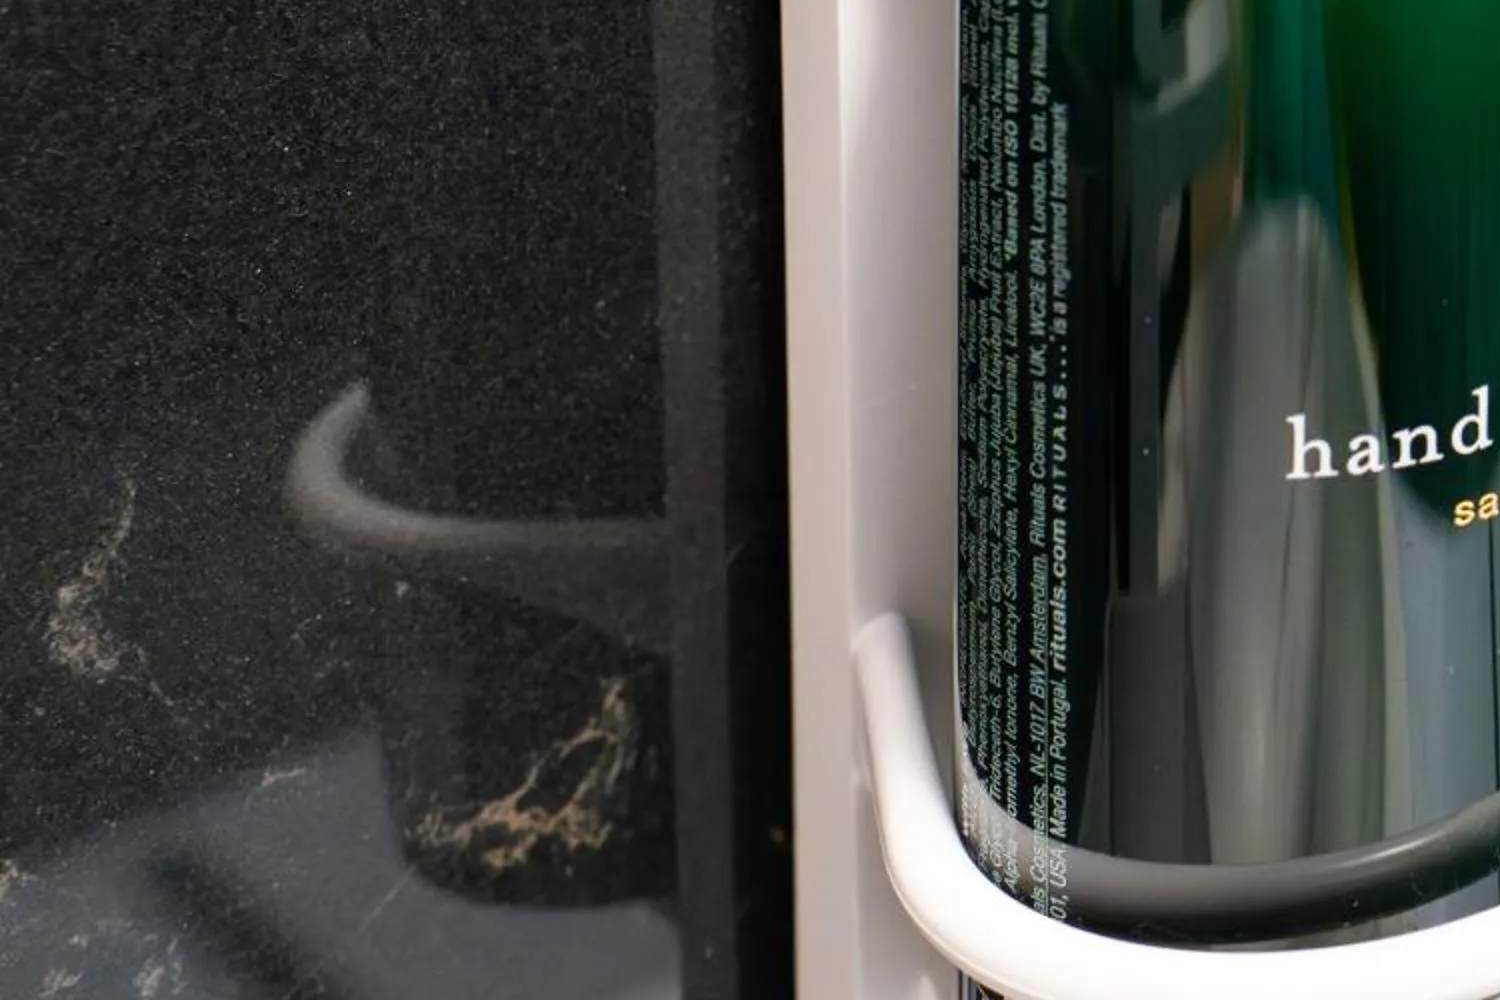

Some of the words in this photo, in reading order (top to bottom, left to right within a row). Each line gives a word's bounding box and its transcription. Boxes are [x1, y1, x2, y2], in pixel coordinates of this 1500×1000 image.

[1031, 13, 1049, 78] Rituals
[1032, 80, 1052, 105] by
[1004, 119, 1019, 158] ISO
[1049, 100, 1069, 199] trademark
[1006, 161, 1019, 188] on
[1050, 201, 1071, 299] registered
[1029, 278, 1047, 337] WC2E
[1053, 300, 1068, 316] a
[1030, 381, 1047, 479] Cosmetics
[1285, 384, 1494, 481] hand
[1003, 447, 1021, 503] Hexyl
[1029, 482, 1047, 548] Rituals
[1003, 507, 1020, 600] Salicylate,
[1029, 552, 1048, 665] Amsterdam,
[1049, 517, 1068, 672] rituals.com
[990, 606, 1002, 688] Butylene
[1003, 601, 1020, 667] Benzyl
[1029, 662, 1046, 700] BW
[1029, 701, 1046, 777] NL-1017
[1049, 678, 1071, 761] Portugal.
[1049, 763, 1066, 782] in
[1030, 783, 1047, 883] Cosmetics,
[1050, 785, 1067, 838] Made
